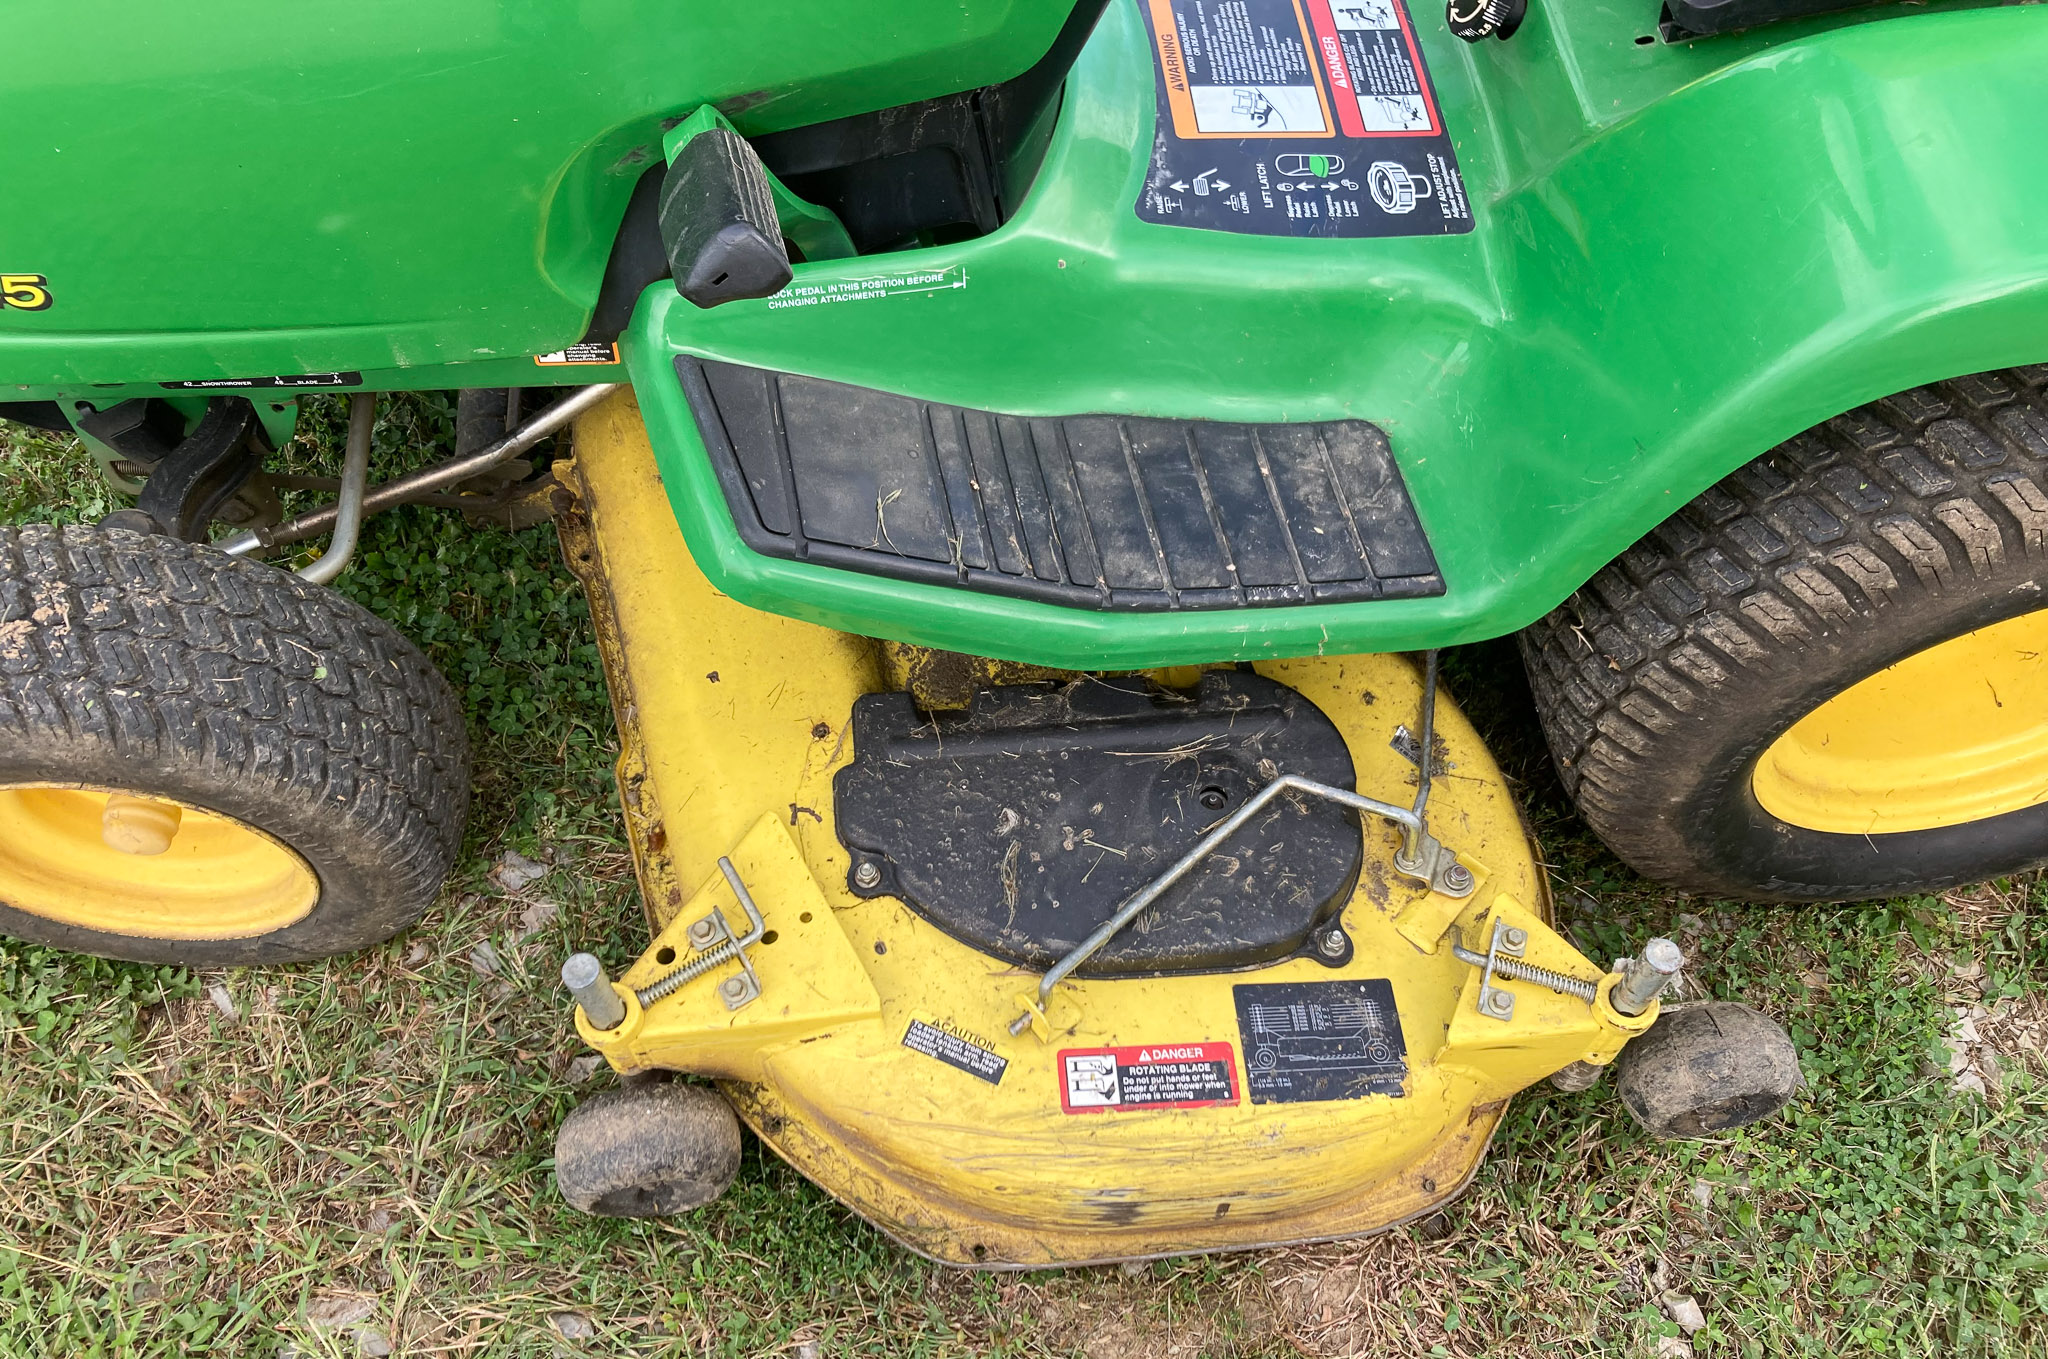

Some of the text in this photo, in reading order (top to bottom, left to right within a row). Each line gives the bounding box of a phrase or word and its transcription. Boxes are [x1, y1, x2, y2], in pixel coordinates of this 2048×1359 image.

[1180, 31, 1192, 55] SERIOUS
[1188, 28, 1201, 55] OR DEATH
[1161, 34, 1183, 84] WARNING
[1186, 56, 1197, 73] AVOID
[1322, 36, 1346, 79] DANGER
[1256, 163, 1274, 208] LIFT LATCH
[1426, 153, 1452, 218] LIFT ADJUST STOP
[1156, 195, 1164, 213] RAISE
[1240, 192, 1250, 214] LOWER
[795, 285, 825, 297] PEDAL
[828, 284, 838, 294] IN
[838, 282, 859, 292] THIS
[862, 278, 905, 289] POSITION
[907, 273, 944, 286] BEFORE
[768, 290, 886, 310] CHANGING ATTACHMENTS
[922, 1025, 943, 1037] avoid
[942, 1034, 964, 1048] injury
[964, 1043, 982, 1054] from
[940, 1021, 996, 1051] CAUTION
[1153, 1047, 1203, 1060] DANGER
[1123, 1077, 1134, 1085] Do
[1136, 1076, 1149, 1084] not
[1151, 1075, 1164, 1085] put
[1166, 1074, 1190, 1083] hands
[1129, 1063, 1211, 1075] ROTATING BLADE
[1124, 1080, 1226, 1093] under or into mower when
[1124, 1093, 1152, 1103] engine
[1163, 1091, 1193, 1100] running
